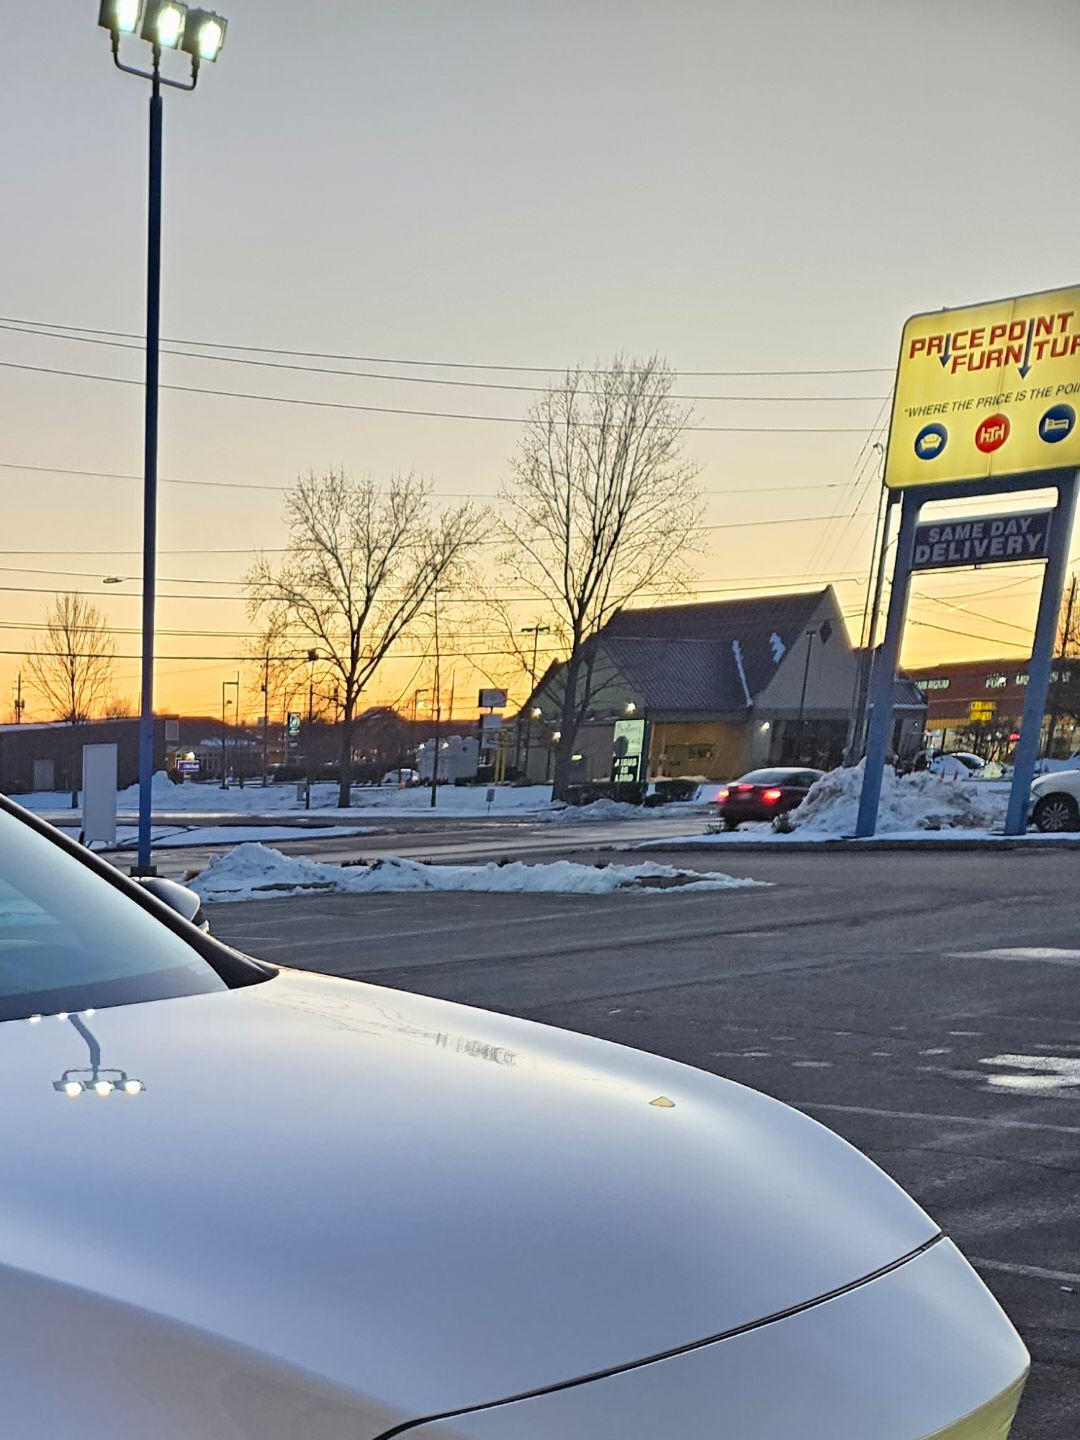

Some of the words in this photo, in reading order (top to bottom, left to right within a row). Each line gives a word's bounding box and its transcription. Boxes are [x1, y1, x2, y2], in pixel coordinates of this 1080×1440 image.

[909, 327, 986, 359] PRICE
[989, 310, 1075, 346] POINT
[951, 398, 974, 412] THE
[976, 391, 1013, 409] PRICE
[1014, 389, 1027, 402] IS
[1029, 385, 1056, 400] THE
[928, 521, 984, 543] SAME
[990, 517, 1033, 537] DAY
[914, 533, 1042, 563] DELIVERY
